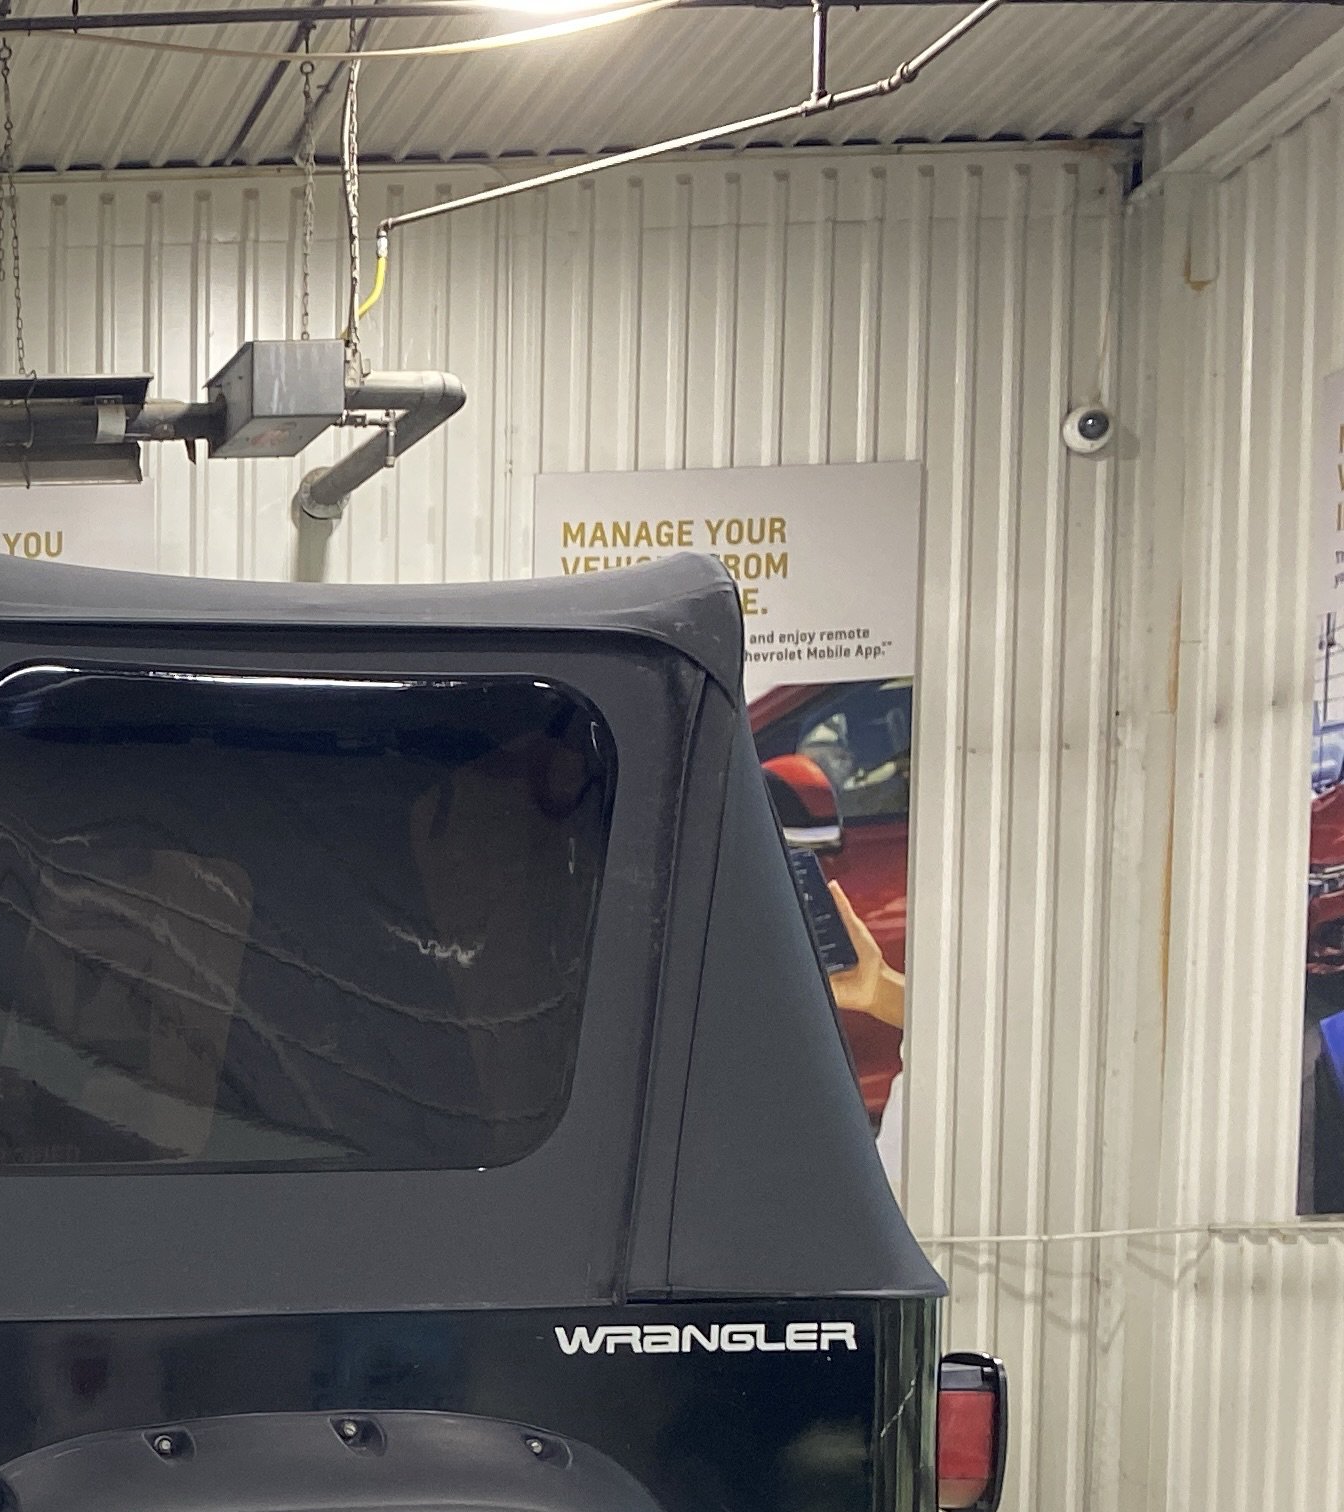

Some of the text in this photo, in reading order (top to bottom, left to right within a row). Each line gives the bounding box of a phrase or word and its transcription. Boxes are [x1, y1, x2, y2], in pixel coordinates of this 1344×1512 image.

[3, 531, 63, 558] YOU
[562, 517, 787, 548] MANAGE YOUR
[724, 552, 788, 580] ROM
[749, 627, 870, 647] and enjoy remote
[744, 648, 802, 662] hevrolet
[807, 644, 850, 660] Mobile
[555, 1322, 857, 1354] WRANGLER
